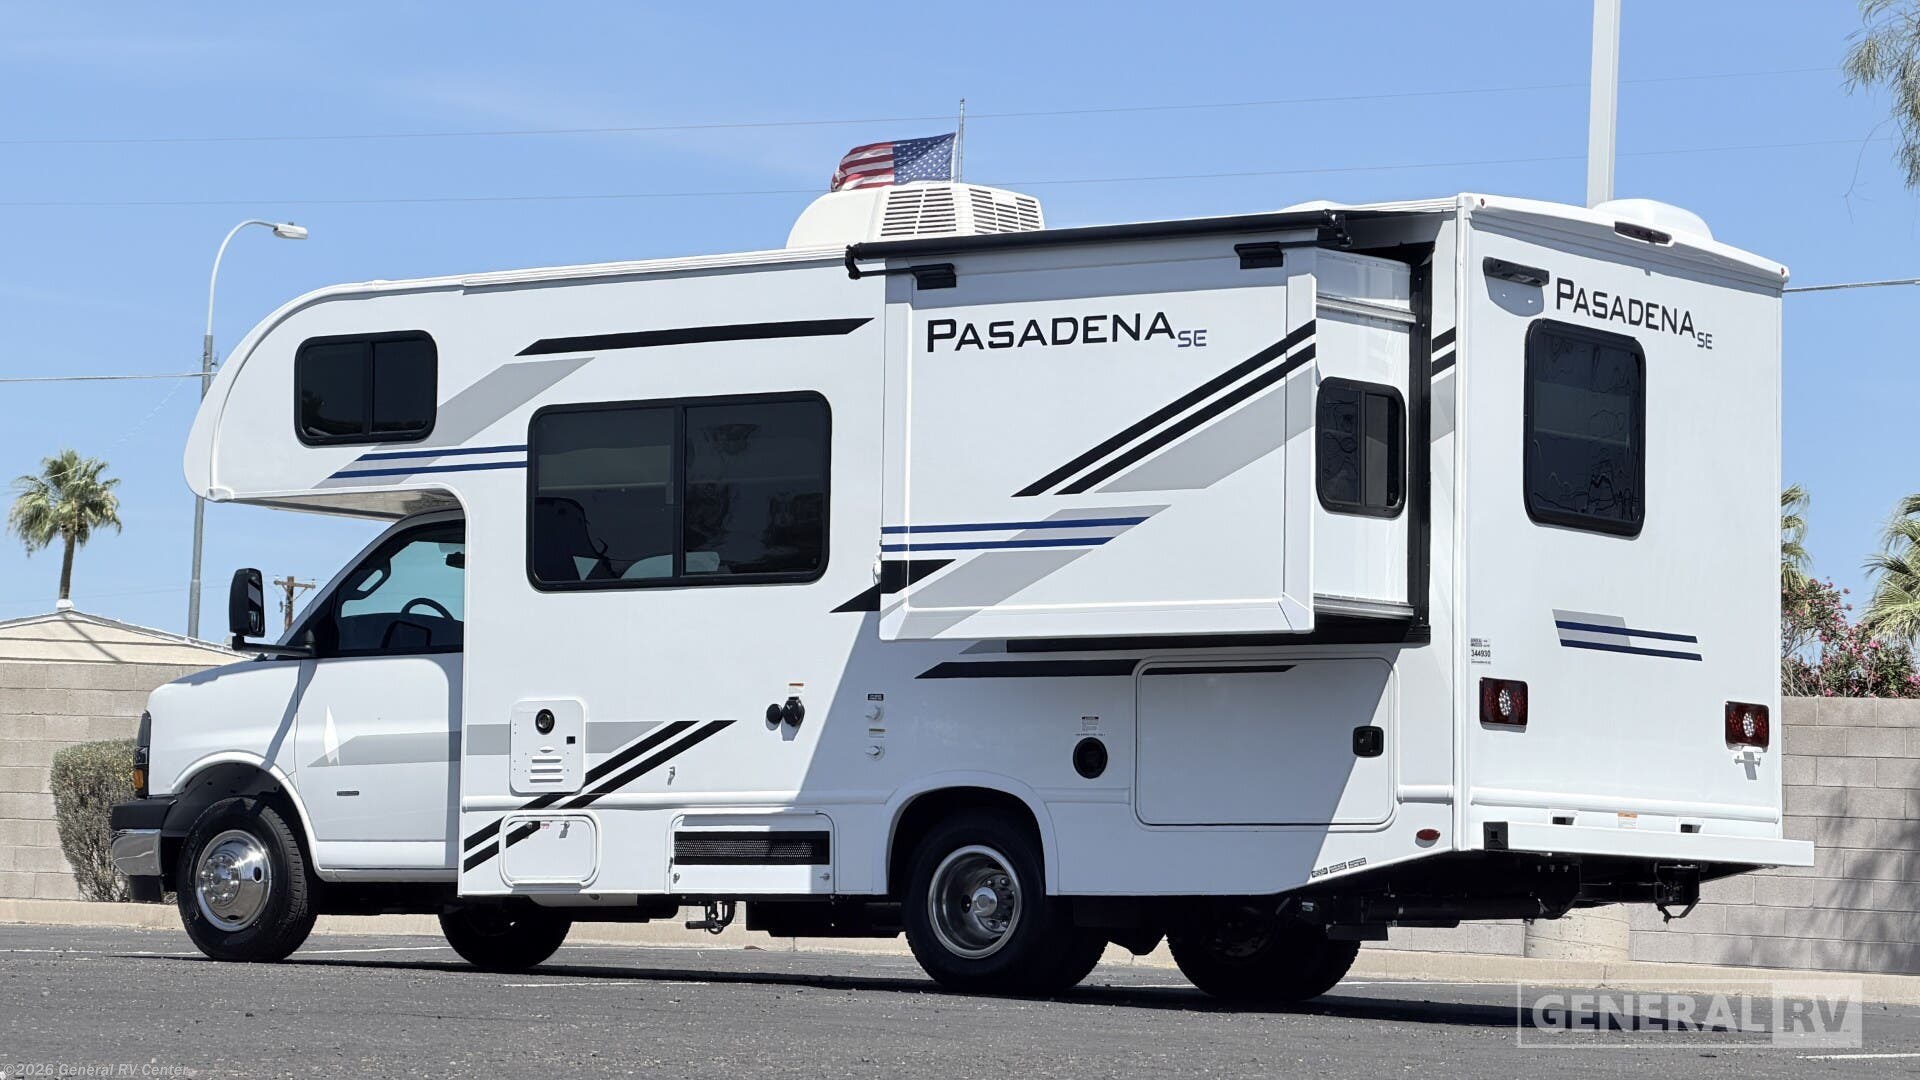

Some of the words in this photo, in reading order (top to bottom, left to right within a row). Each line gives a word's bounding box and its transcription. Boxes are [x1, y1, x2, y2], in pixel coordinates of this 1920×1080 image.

[927, 311, 1176, 353] PASADENA
[1177, 329, 1208, 348] SE
[1556, 277, 1696, 339] PASADENA
[1696, 331, 1713, 350] SE
